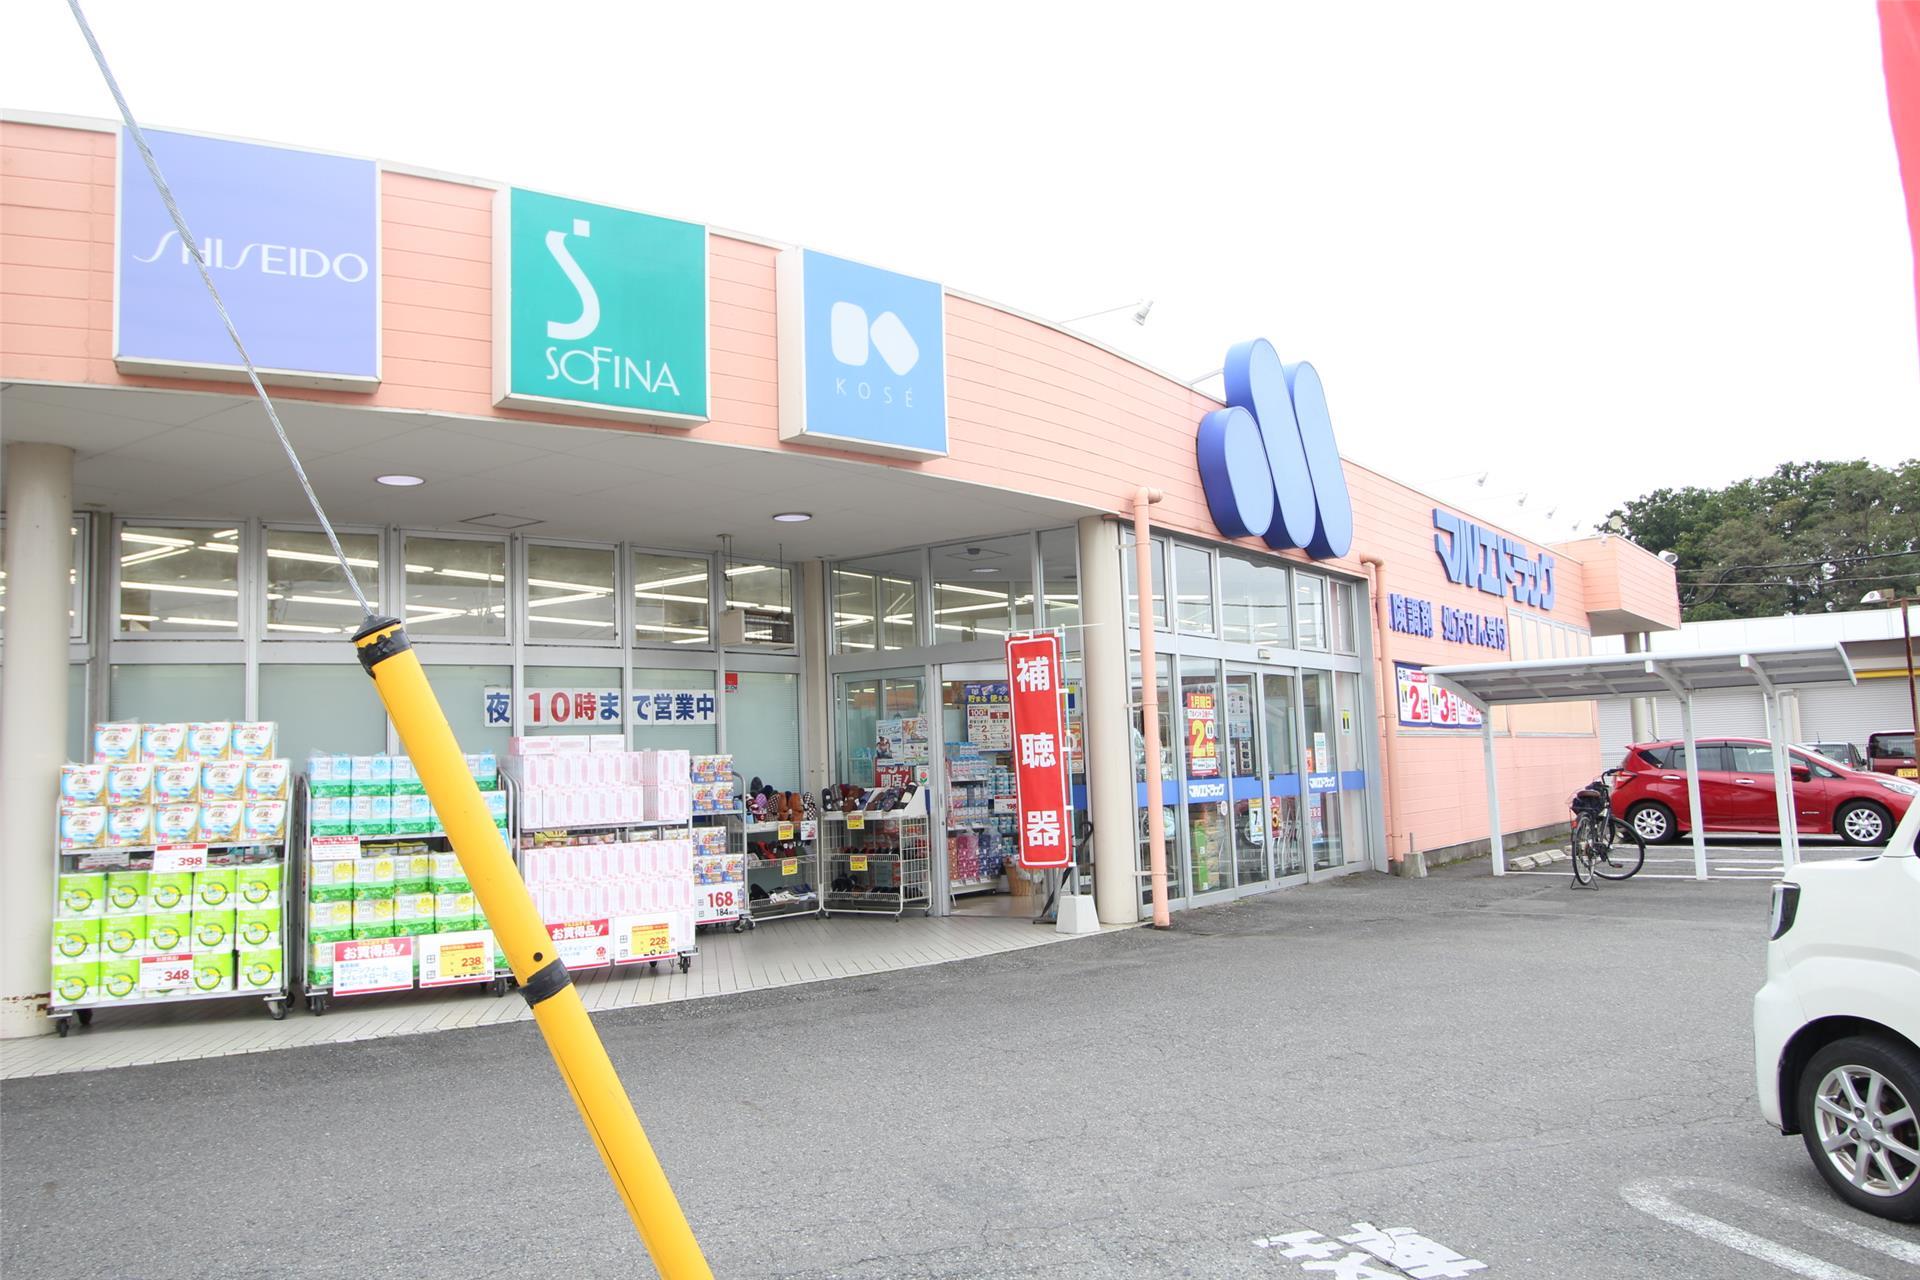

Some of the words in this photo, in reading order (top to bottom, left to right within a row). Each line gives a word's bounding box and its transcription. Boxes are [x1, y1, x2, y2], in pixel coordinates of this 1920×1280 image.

[133, 230, 368, 283] SHISEIDO
[545, 346, 680, 396] SOFINA
[836, 378, 914, 408] KOSÉ
[1432, 508, 1554, 611] マルエドラッグ
[1388, 593, 1433, 638] 険調剤
[1016, 656, 1060, 846] 補聴器
[178, 857, 202, 866] 398
[707, 891, 734, 908] 168
[650, 936, 667, 946] 228
[164, 969, 190, 981] 348
[462, 956, 482, 967] 238
